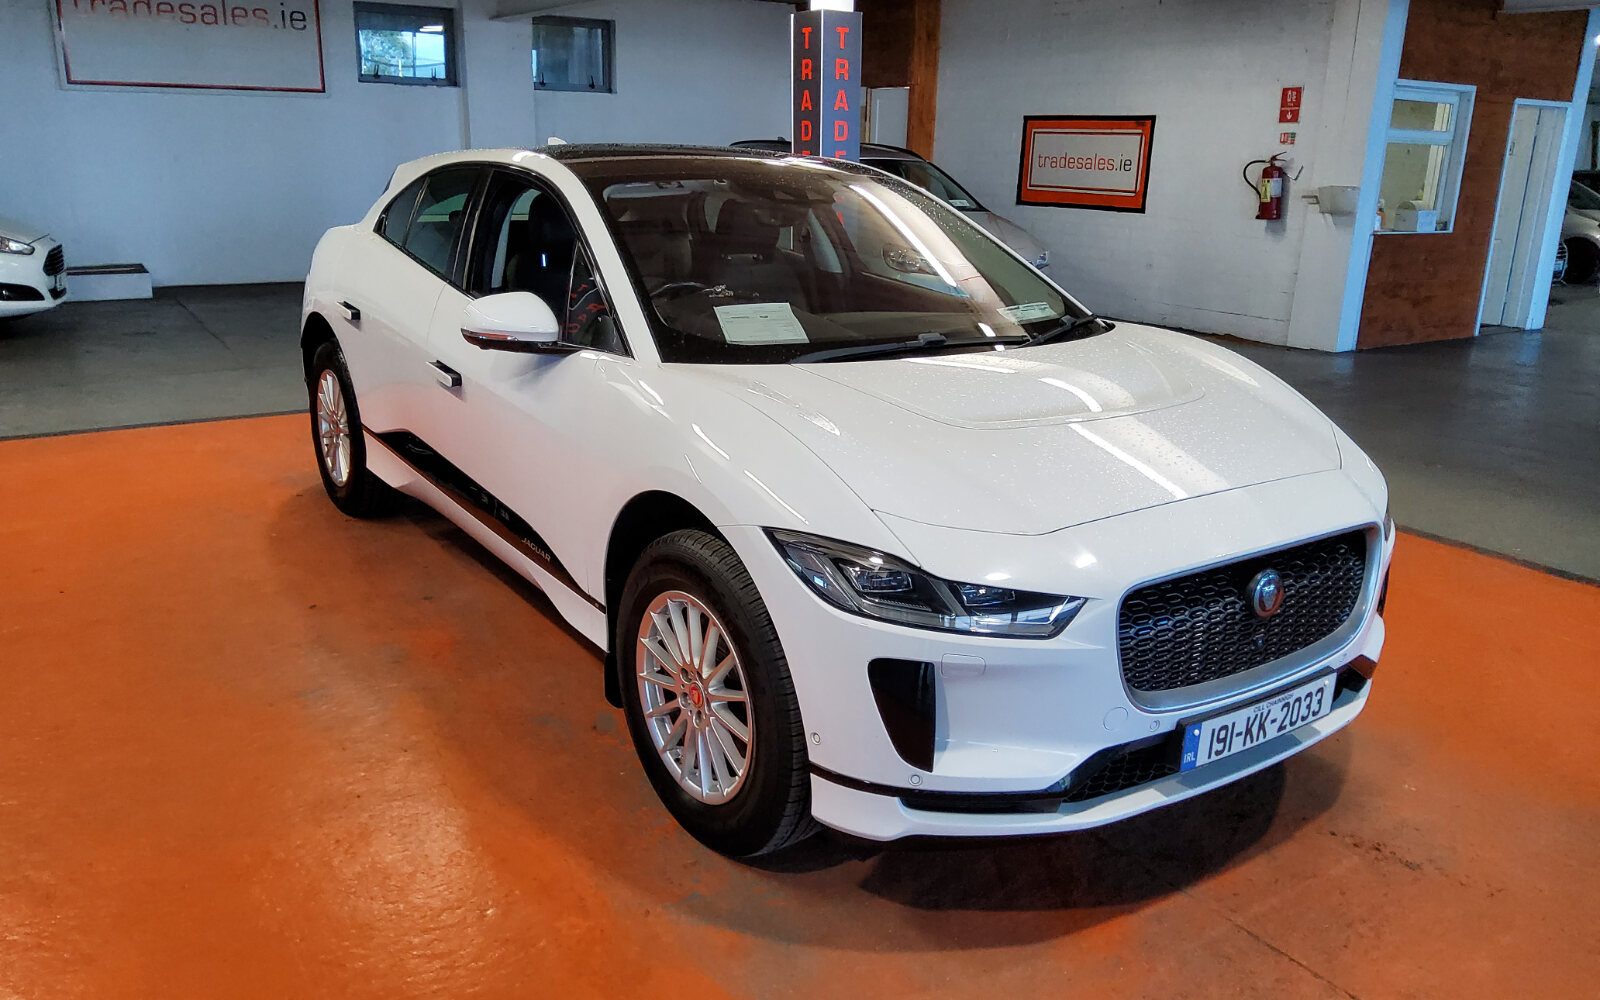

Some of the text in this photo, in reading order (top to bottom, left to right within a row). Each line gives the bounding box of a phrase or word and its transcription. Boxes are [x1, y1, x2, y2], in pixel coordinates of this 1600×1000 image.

[801, 26, 812, 155] TRAD
[1038, 152, 1132, 172] tradesales.ie
[521, 537, 551, 562] JAGUAR
[1207, 686, 1324, 760] 191-KK-2033
[1183, 752, 1195, 764] IRL
